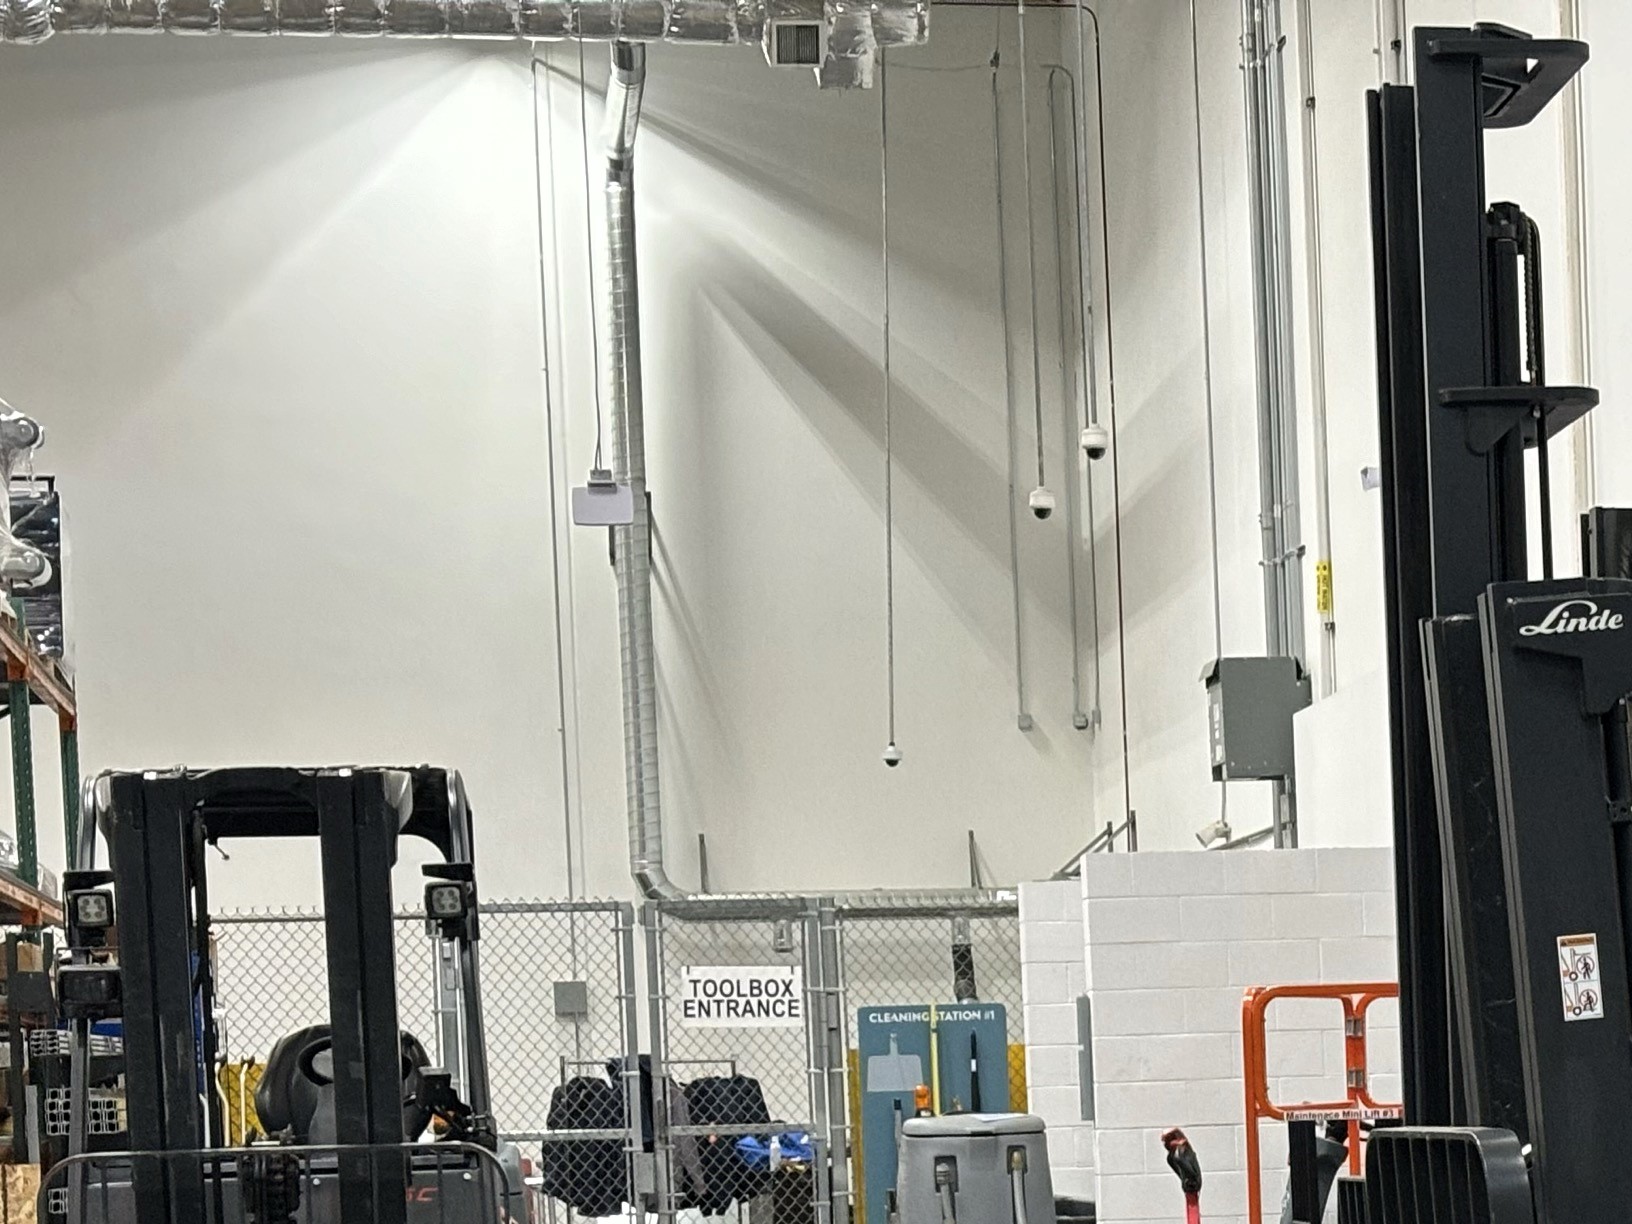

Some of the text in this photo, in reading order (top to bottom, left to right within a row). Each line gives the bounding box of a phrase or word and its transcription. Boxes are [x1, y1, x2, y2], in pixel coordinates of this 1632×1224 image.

[1519, 599, 1624, 636] Linde
[688, 978, 794, 998] TOOLBOX
[683, 998, 800, 1018] ENTRANCE
[868, 1011, 930, 1023] CLEANING
[1342, 1108, 1362, 1119] Mini
[1364, 1107, 1380, 1119] Lift
